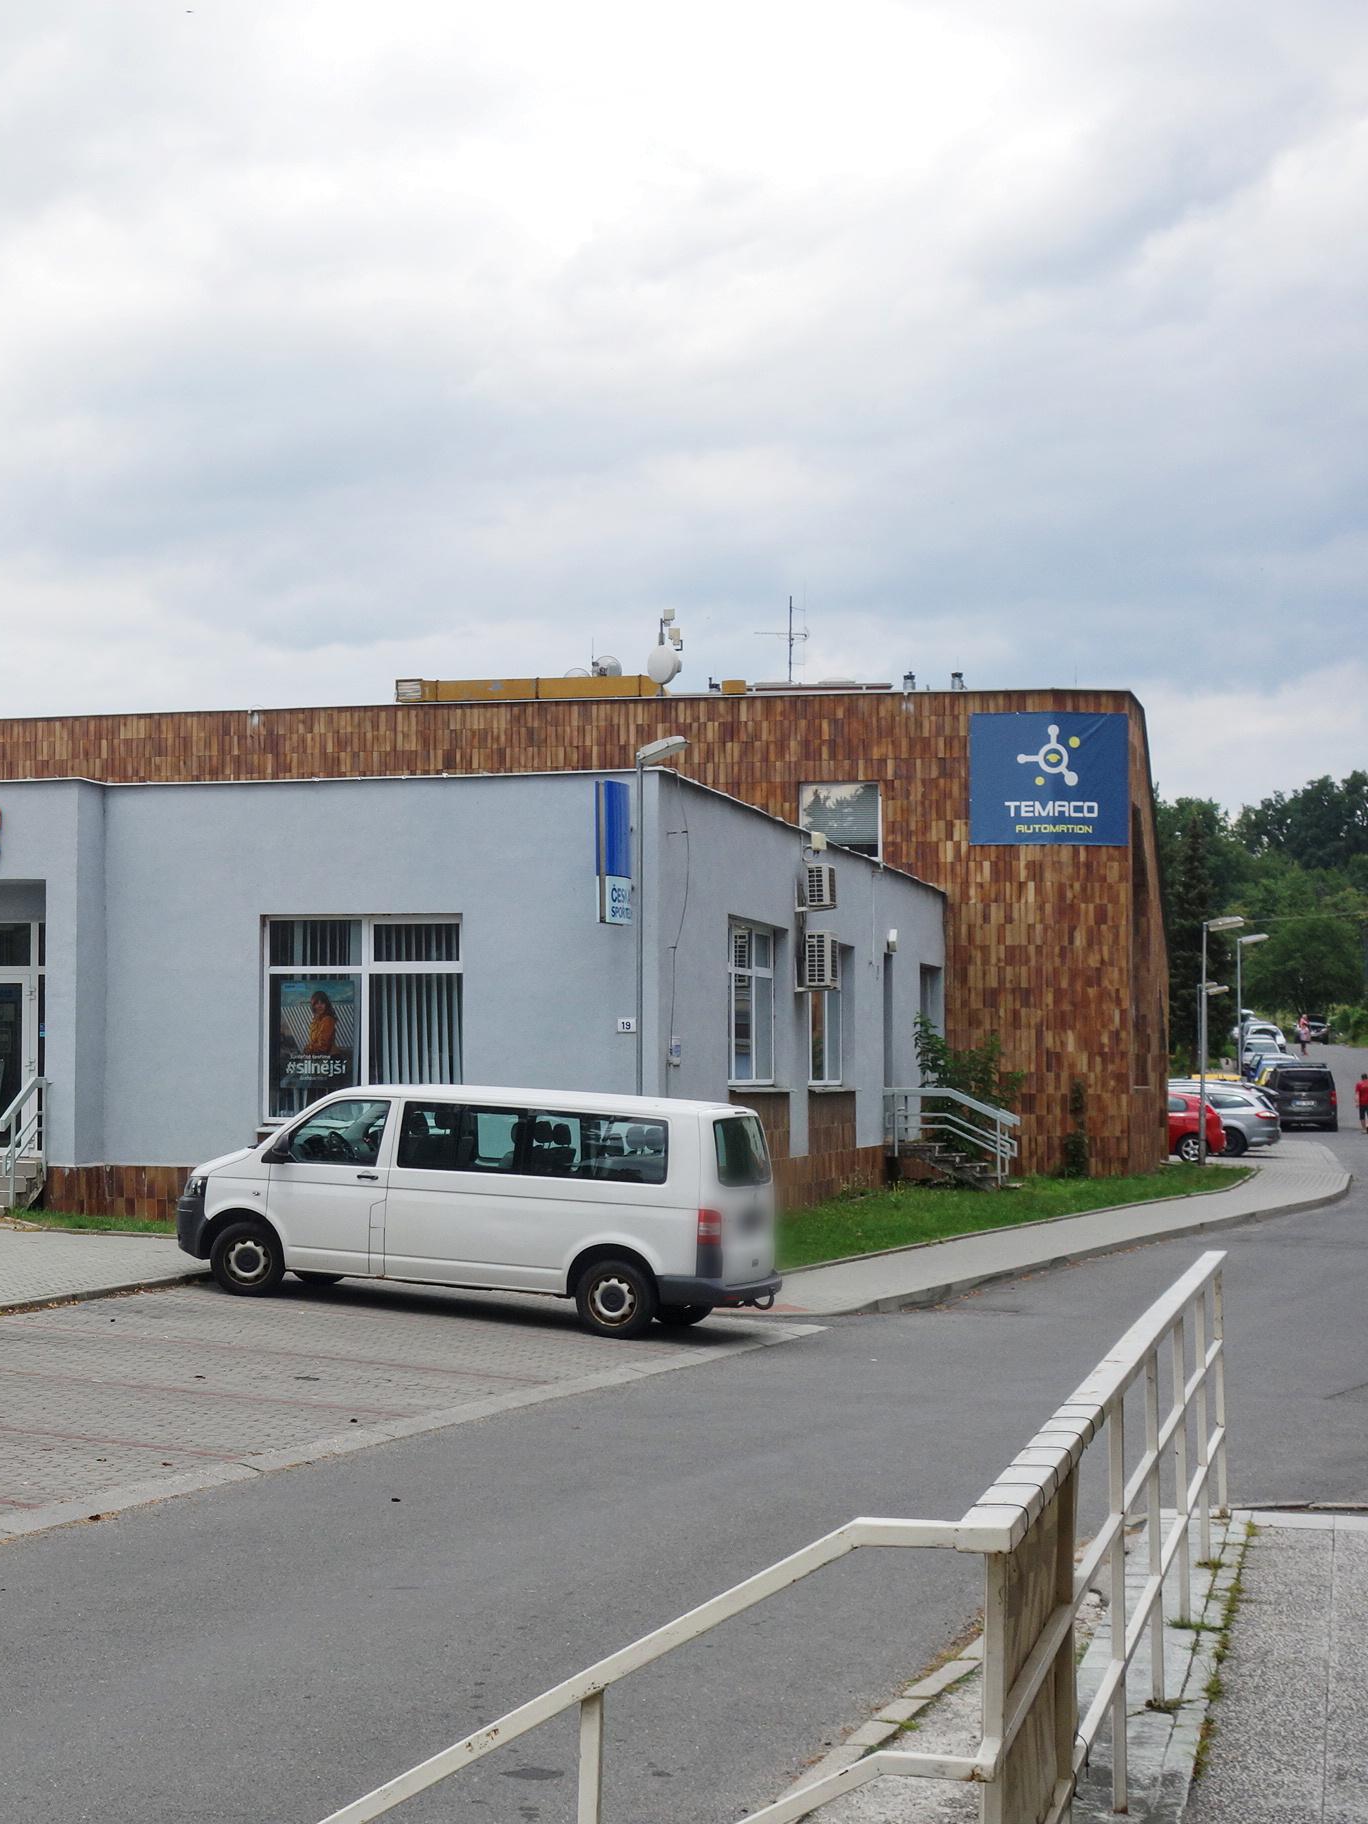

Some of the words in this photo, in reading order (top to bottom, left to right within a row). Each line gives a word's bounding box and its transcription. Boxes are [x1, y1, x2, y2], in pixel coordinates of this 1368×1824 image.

[1004, 801, 1099, 818] TEMACO
[1015, 824, 1093, 834] AUTOMATION
[621, 1021, 632, 1031] 19
[286, 1060, 347, 1077] #silnější
